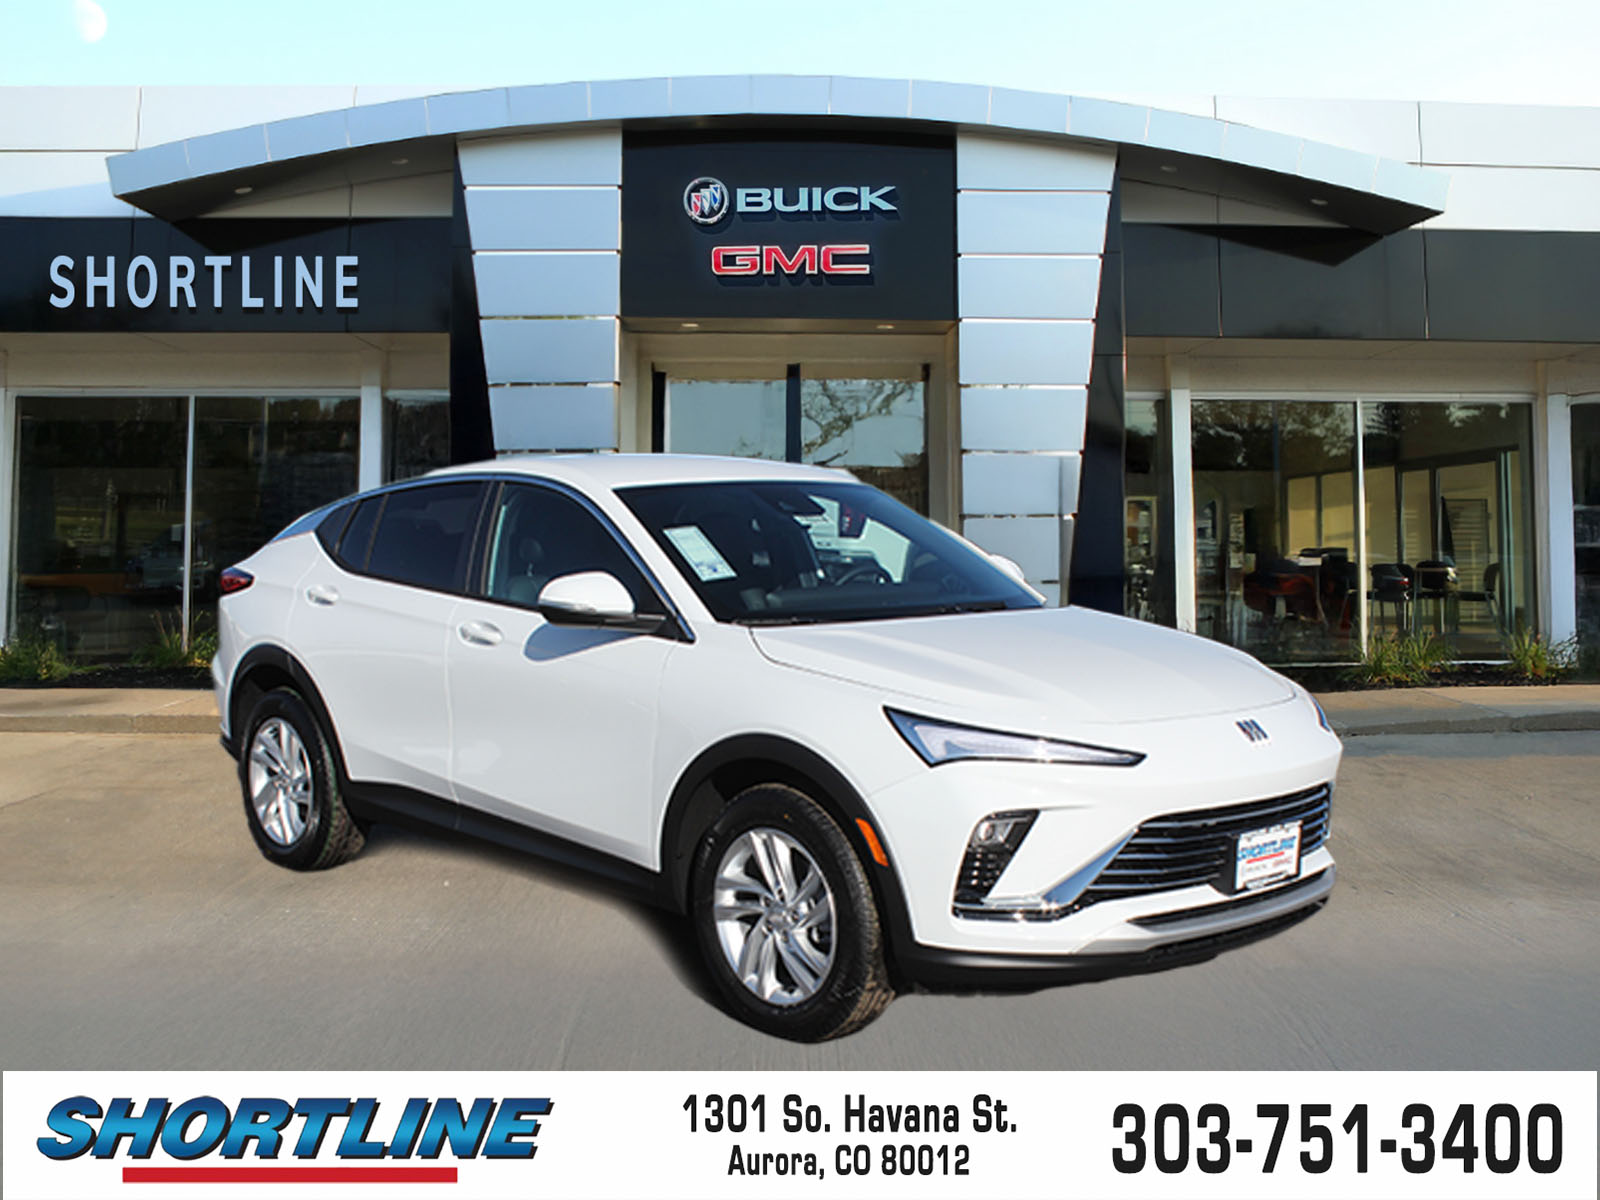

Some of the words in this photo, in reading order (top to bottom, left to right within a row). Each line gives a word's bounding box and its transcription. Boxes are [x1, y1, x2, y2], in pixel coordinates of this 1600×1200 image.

[736, 186, 897, 212] BUICK
[711, 244, 870, 275] GMC
[49, 255, 359, 308] SHORTLINE
